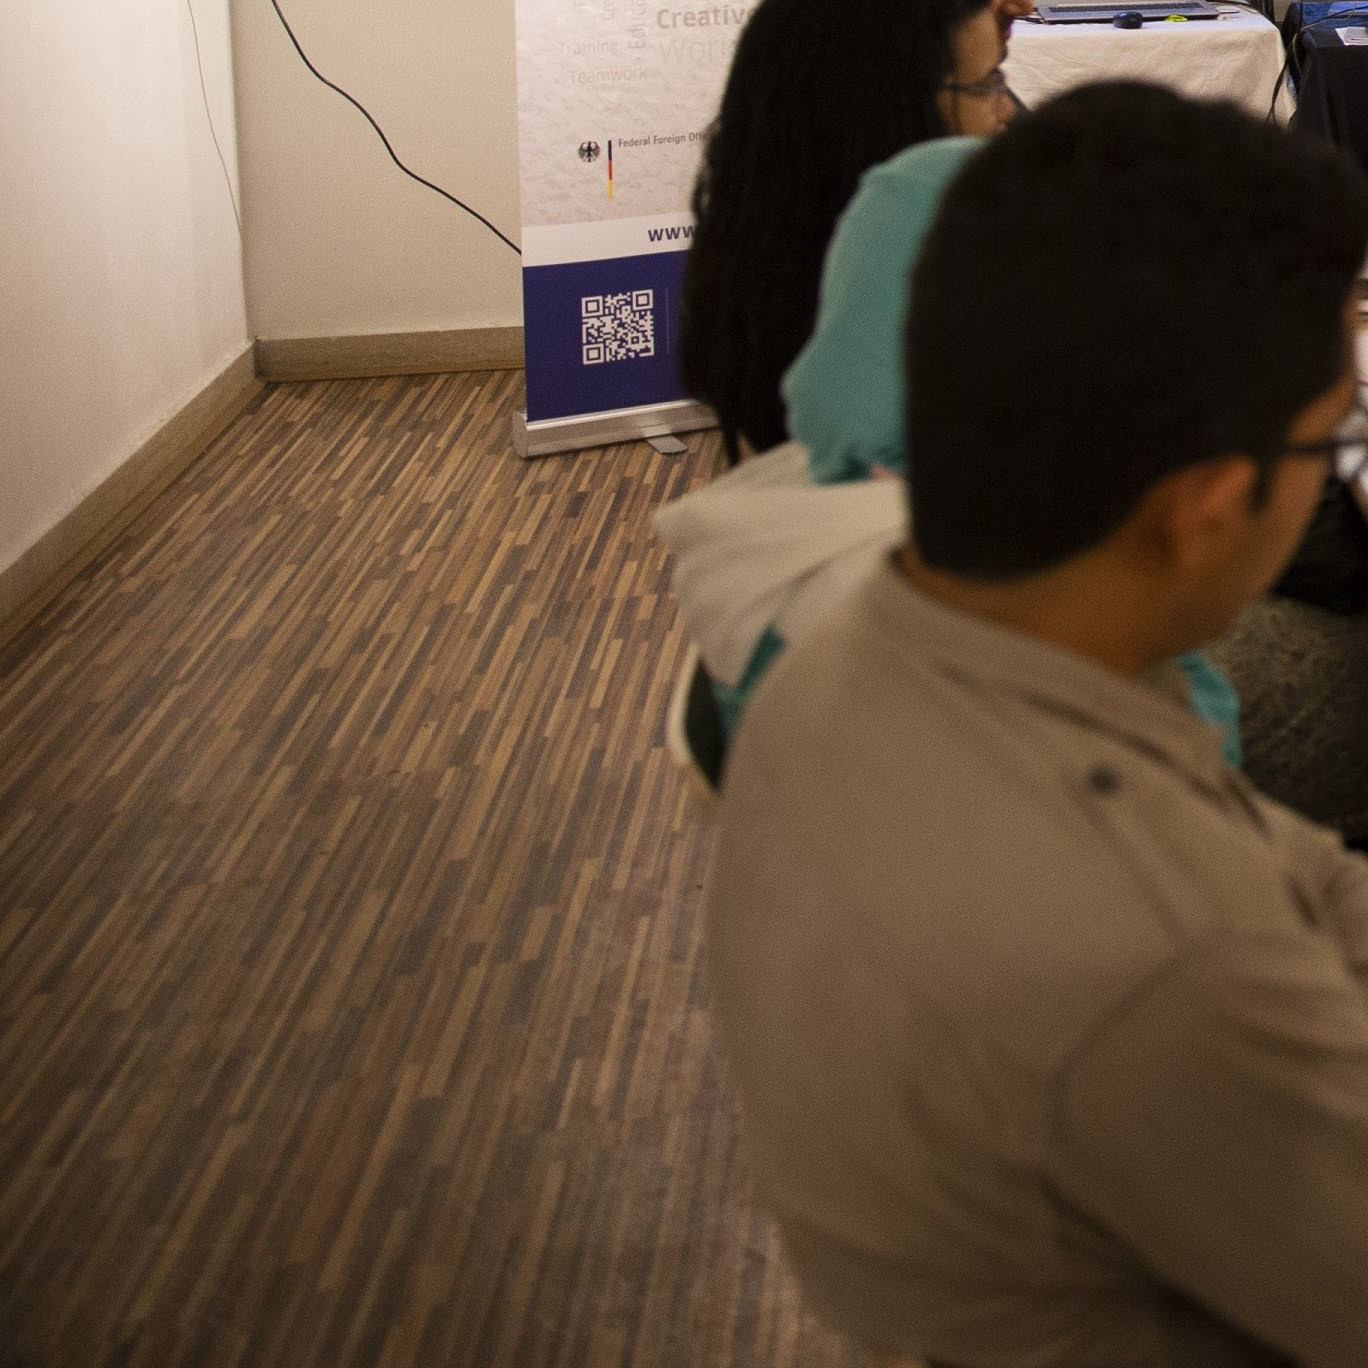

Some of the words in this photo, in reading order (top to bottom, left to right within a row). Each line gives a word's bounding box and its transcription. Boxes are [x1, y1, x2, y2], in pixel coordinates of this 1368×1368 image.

[656, 5, 747, 30] Creativ
[569, 68, 648, 86] Teamwork
[618, 134, 651, 148] Federal
[653, 133, 687, 146] Foreign
